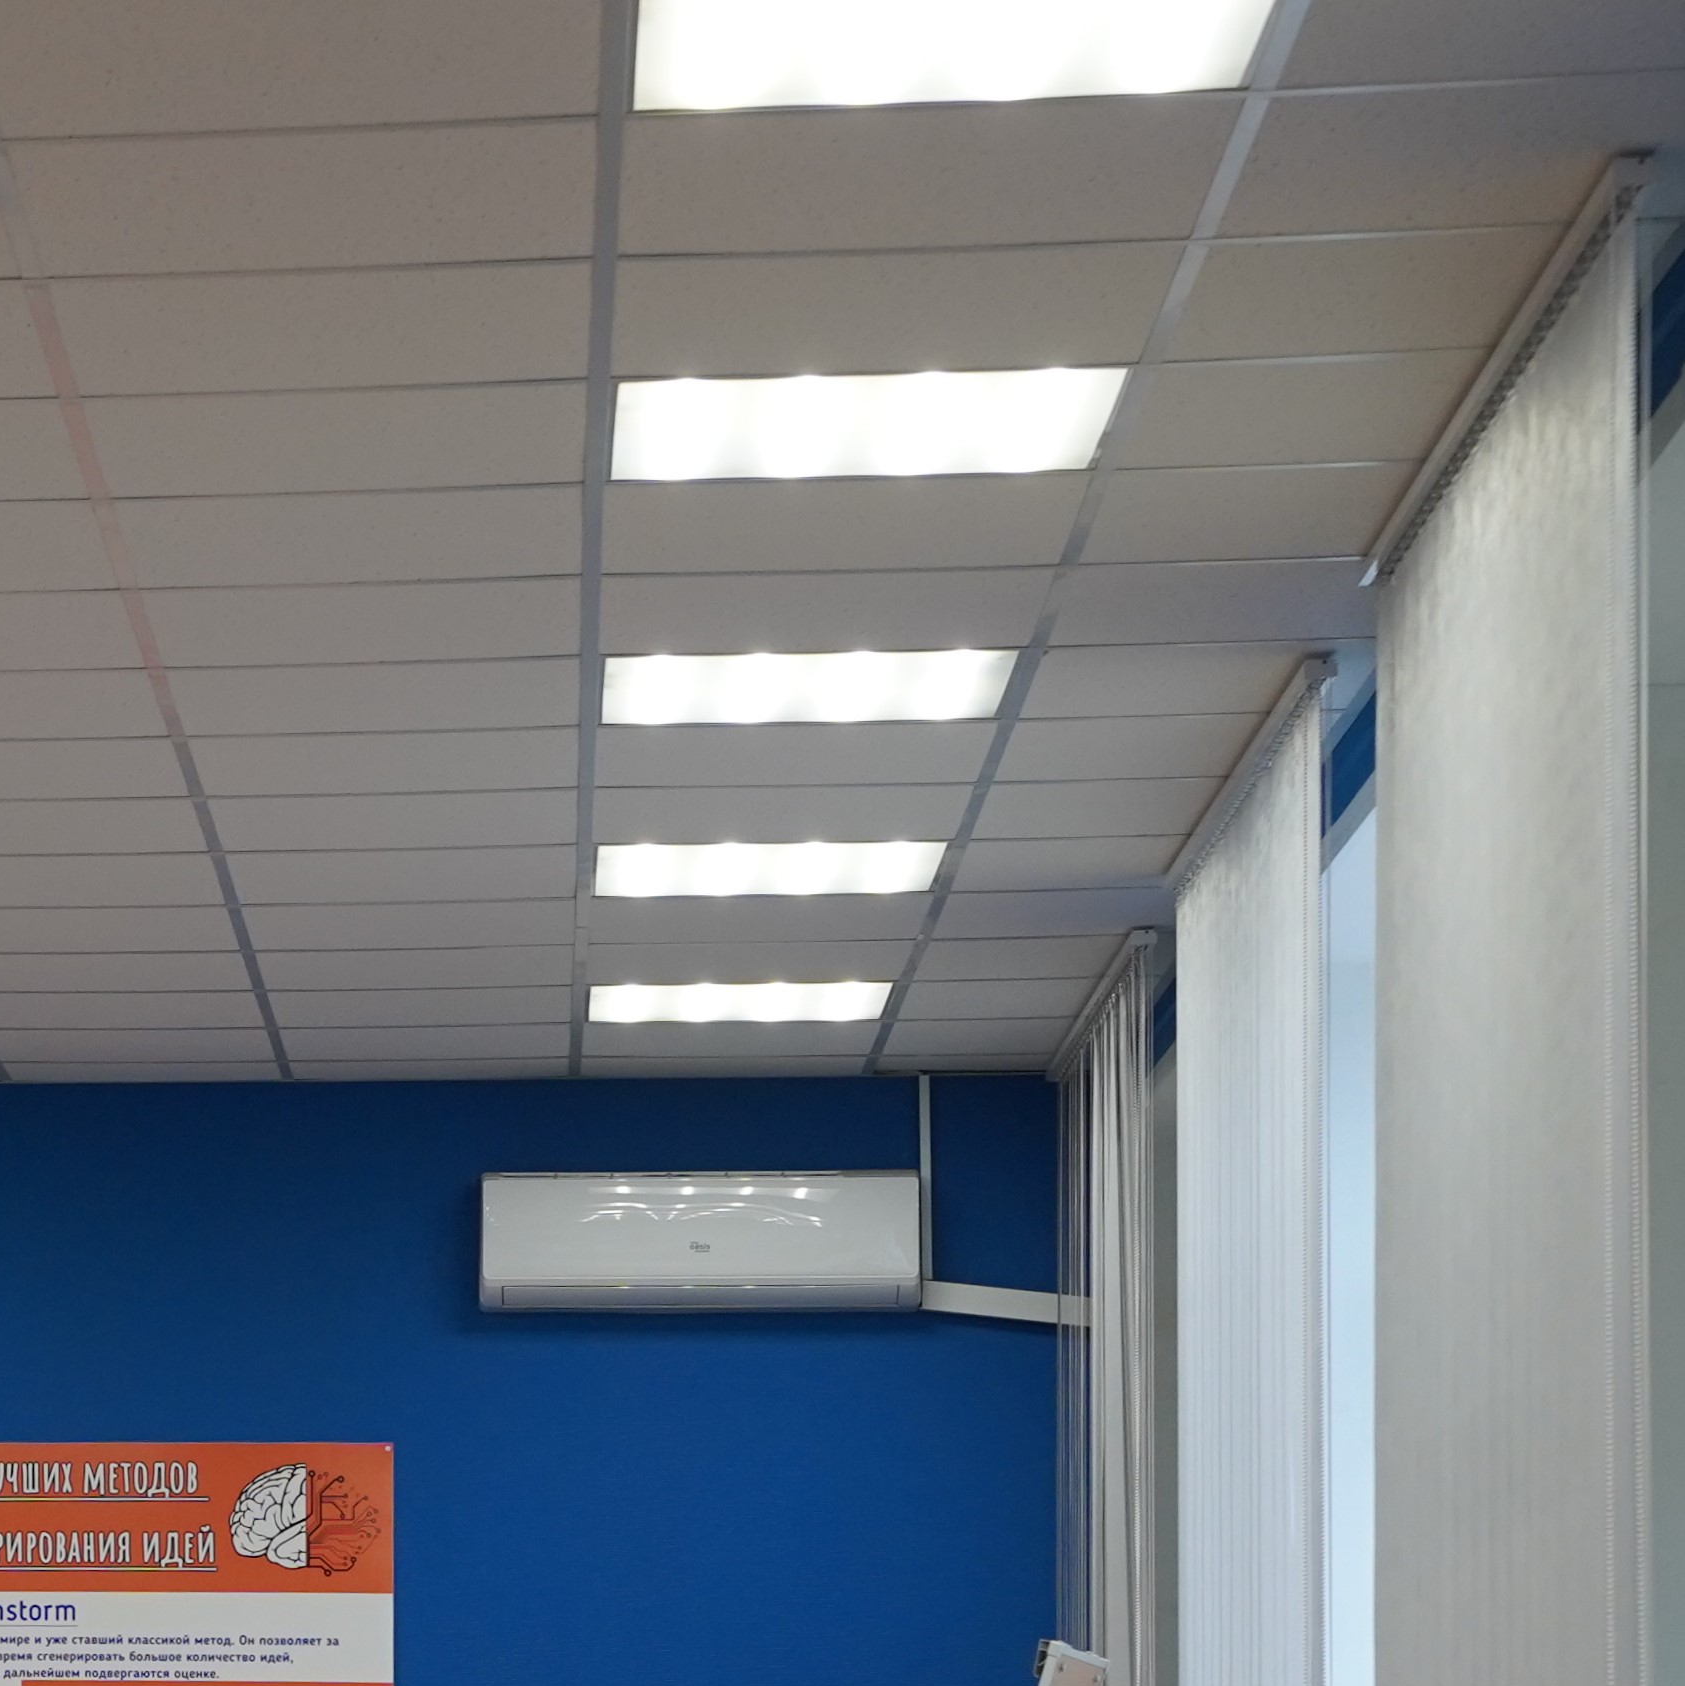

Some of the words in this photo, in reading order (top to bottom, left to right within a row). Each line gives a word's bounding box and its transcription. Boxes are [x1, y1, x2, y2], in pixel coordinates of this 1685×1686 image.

[82, 1461, 198, 1499] МЕТОДОВ
[142, 1524, 214, 1568] ИДЕЙ
[33, 1636, 42, 1644] и
[44, 1636, 68, 1647] уже
[70, 1633, 124, 1645] ставший
[126, 1634, 190, 1645] классикой
[193, 1636, 236, 1647] метод.
[238, 1633, 255, 1645] Он
[258, 1636, 322, 1646] позволяет
[325, 1637, 340, 1646] за
[35, 1652, 126, 1664] сгенерировать
[128, 1650, 182, 1662] большое
[185, 1653, 256, 1662] количество
[259, 1651, 295, 1664] идей,
[1, 1667, 80, 1682] дальнейшем
[83, 1669, 170, 1683] подвергаются
[172, 1669, 220, 1683] оценке.
